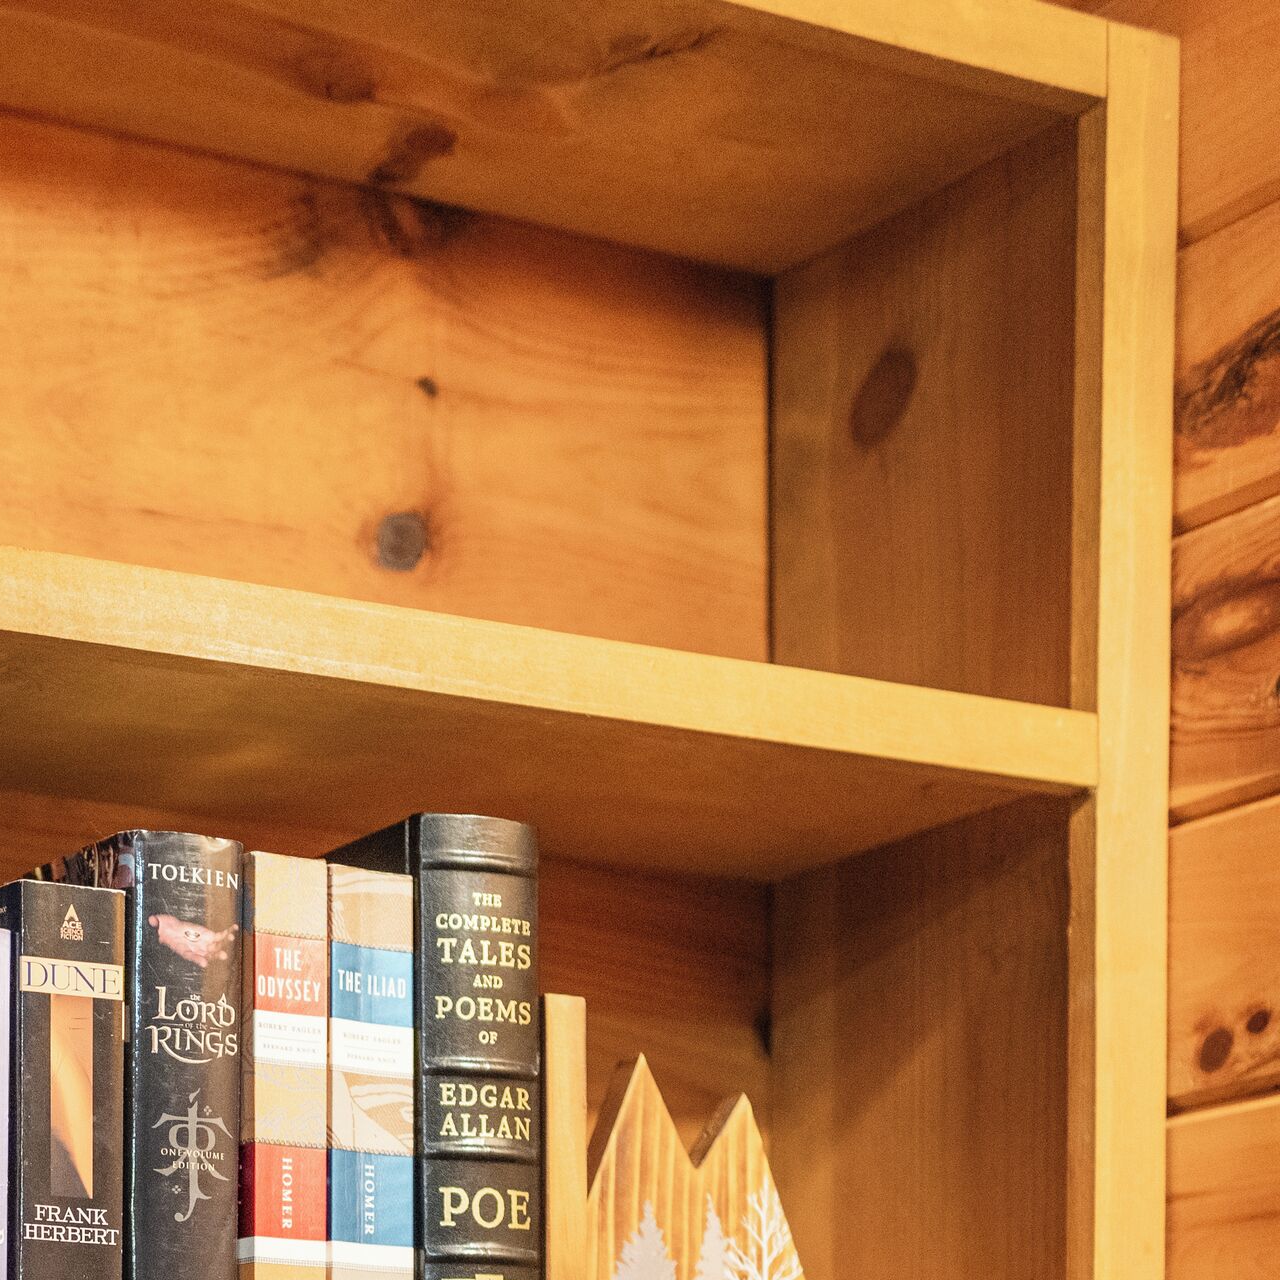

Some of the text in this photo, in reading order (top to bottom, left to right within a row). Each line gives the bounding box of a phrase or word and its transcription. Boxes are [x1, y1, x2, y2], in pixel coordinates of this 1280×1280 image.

[147, 861, 239, 891] TOLKIEN
[472, 892, 503, 907] THE
[61, 920, 83, 929] ACE
[435, 913, 532, 936] COMPLETE
[273, 946, 302, 974] THE
[436, 938, 532, 969] TALES
[23, 960, 121, 995] DUNE
[257, 974, 321, 1003] ODYSSEY
[337, 968, 407, 999] THE ILIAD
[472, 973, 503, 989] AND
[435, 996, 532, 1026] POEMS
[478, 1030, 498, 1044] OF
[439, 1084, 532, 1111] EDGAR
[439, 1114, 532, 1142] ALLAN
[280, 1156, 294, 1232] HOMER
[363, 1163, 375, 1237] HOMER
[439, 1184, 532, 1231] POE
[34, 1204, 109, 1226] FRANK
[23, 1223, 120, 1246] HERBERT
